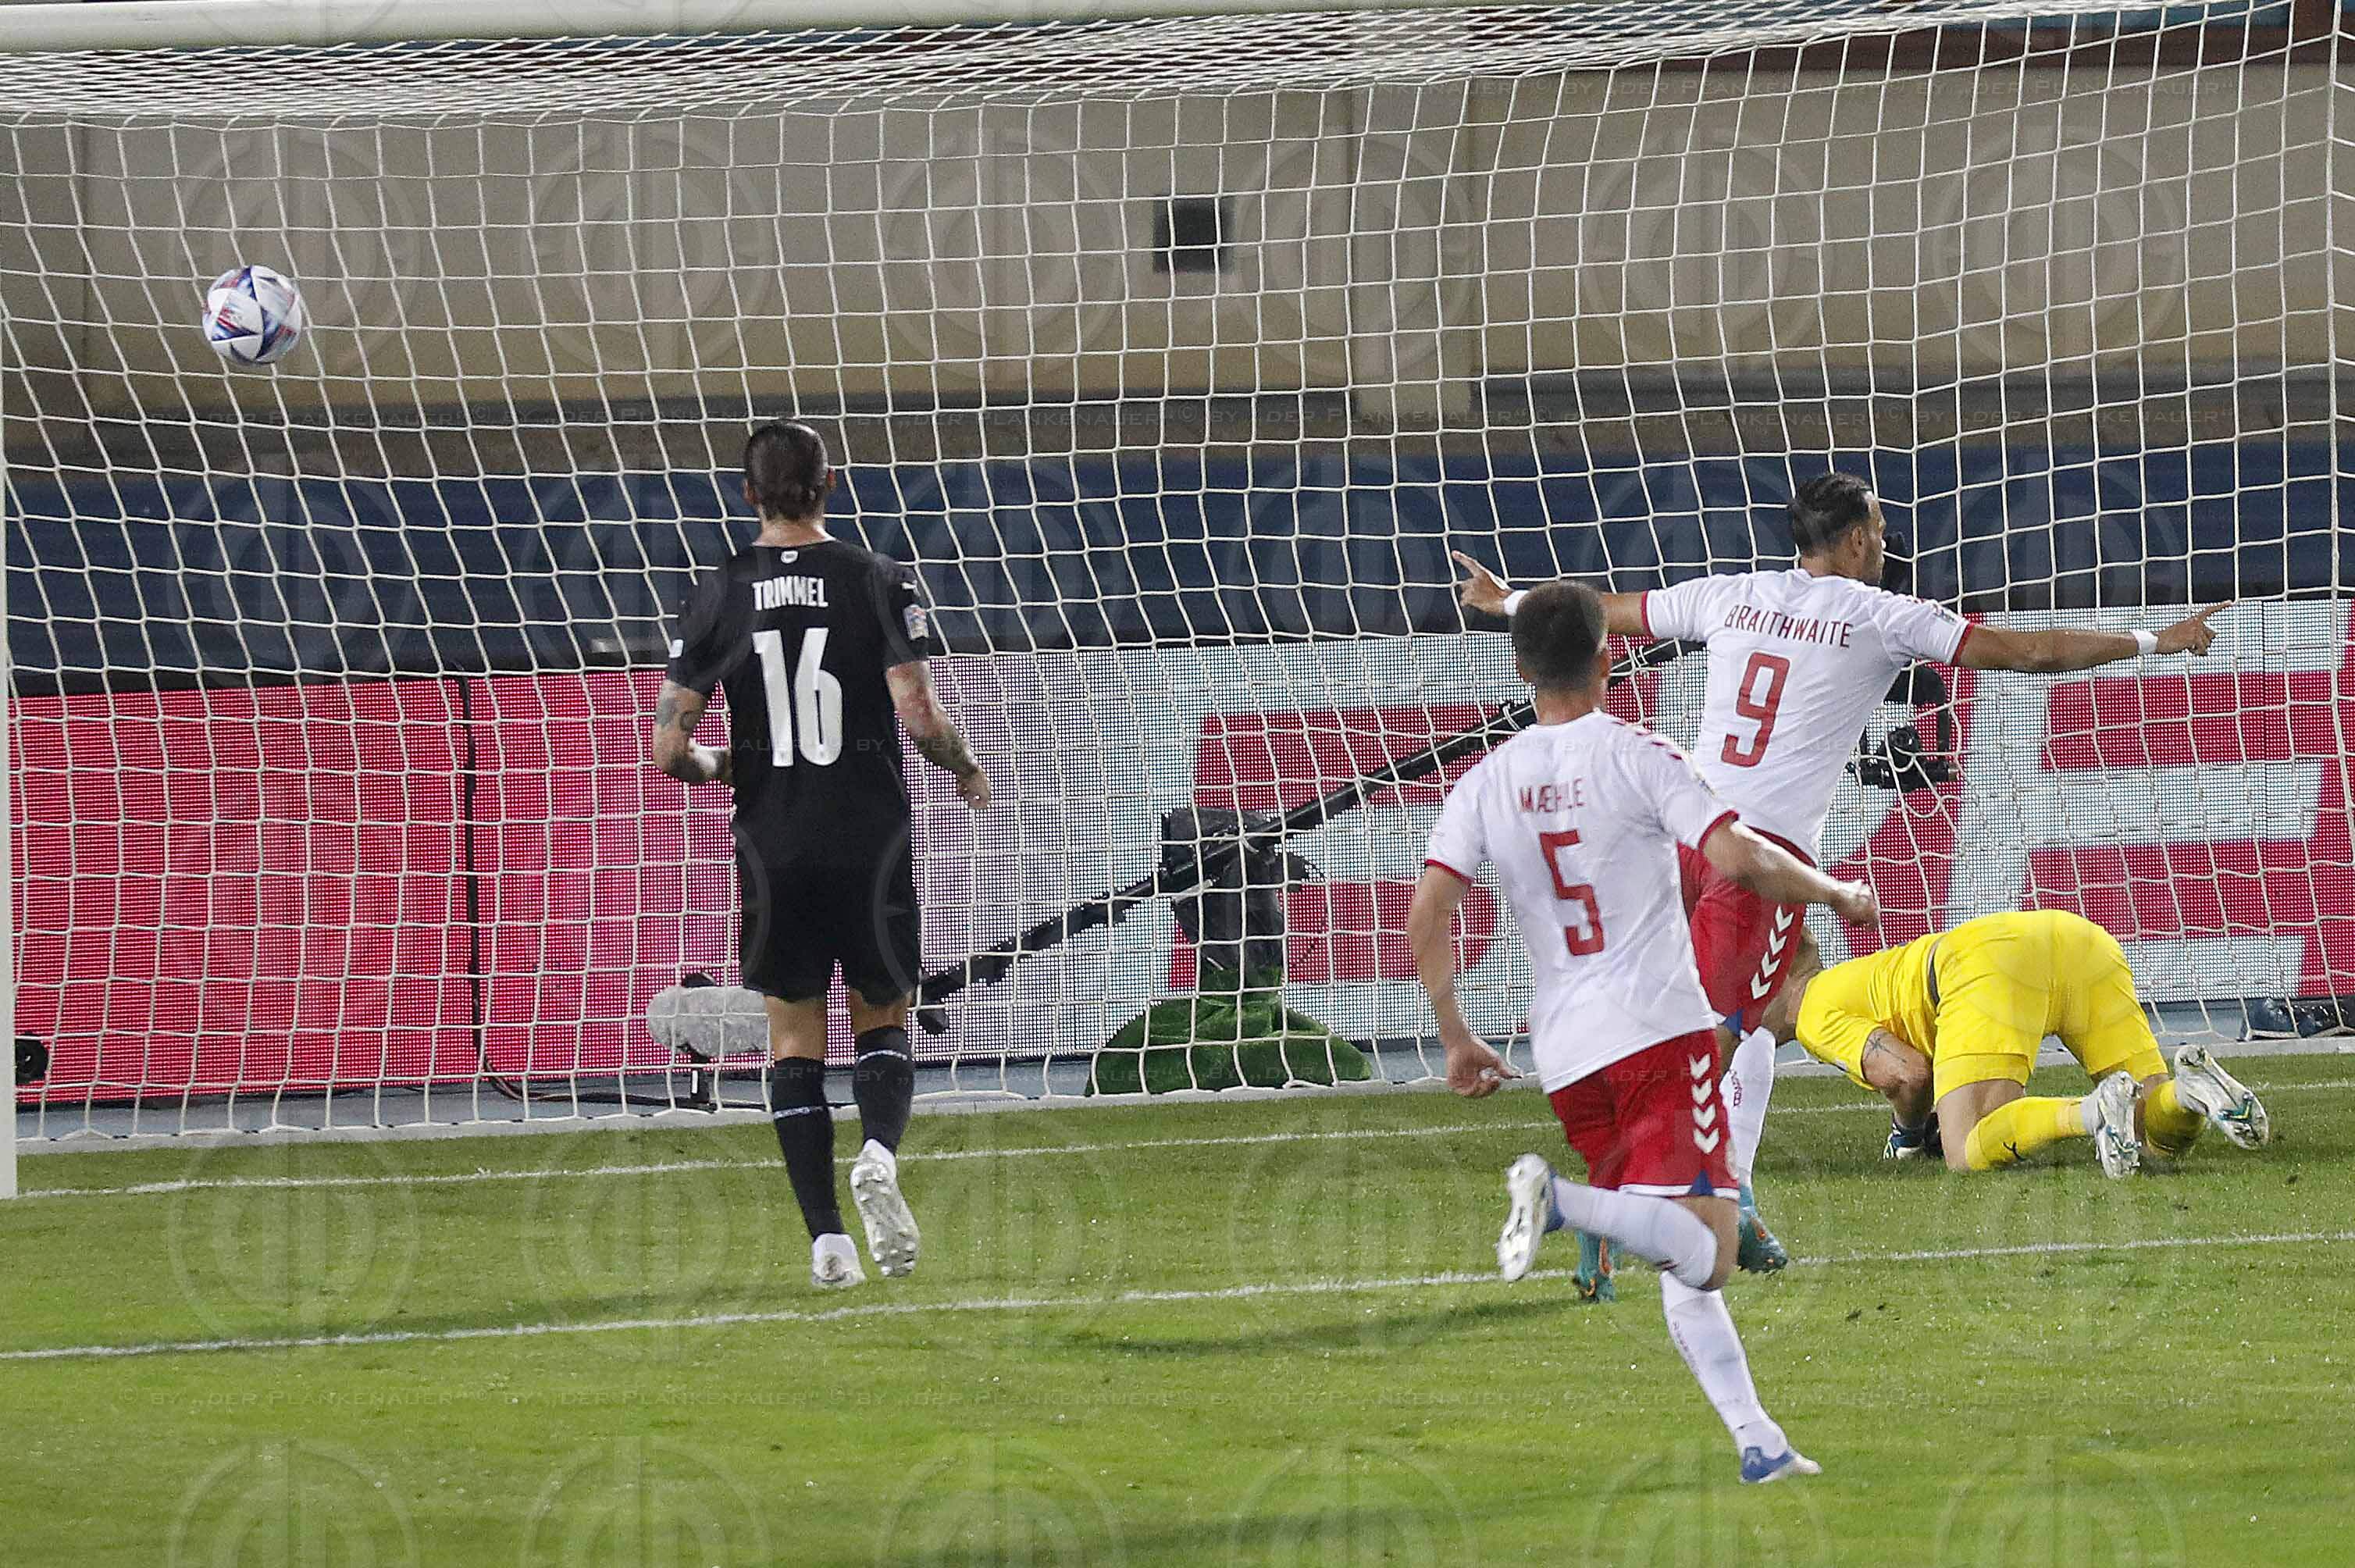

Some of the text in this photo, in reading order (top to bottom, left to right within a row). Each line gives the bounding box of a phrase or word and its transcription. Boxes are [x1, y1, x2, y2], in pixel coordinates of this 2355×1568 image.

[752, 576, 828, 611] TRIMMEL
[1724, 604, 1853, 648] BRAITHWAITE
[752, 627, 843, 767] 16
[1720, 651, 1790, 768] 9
[1538, 829, 1604, 956] 5
